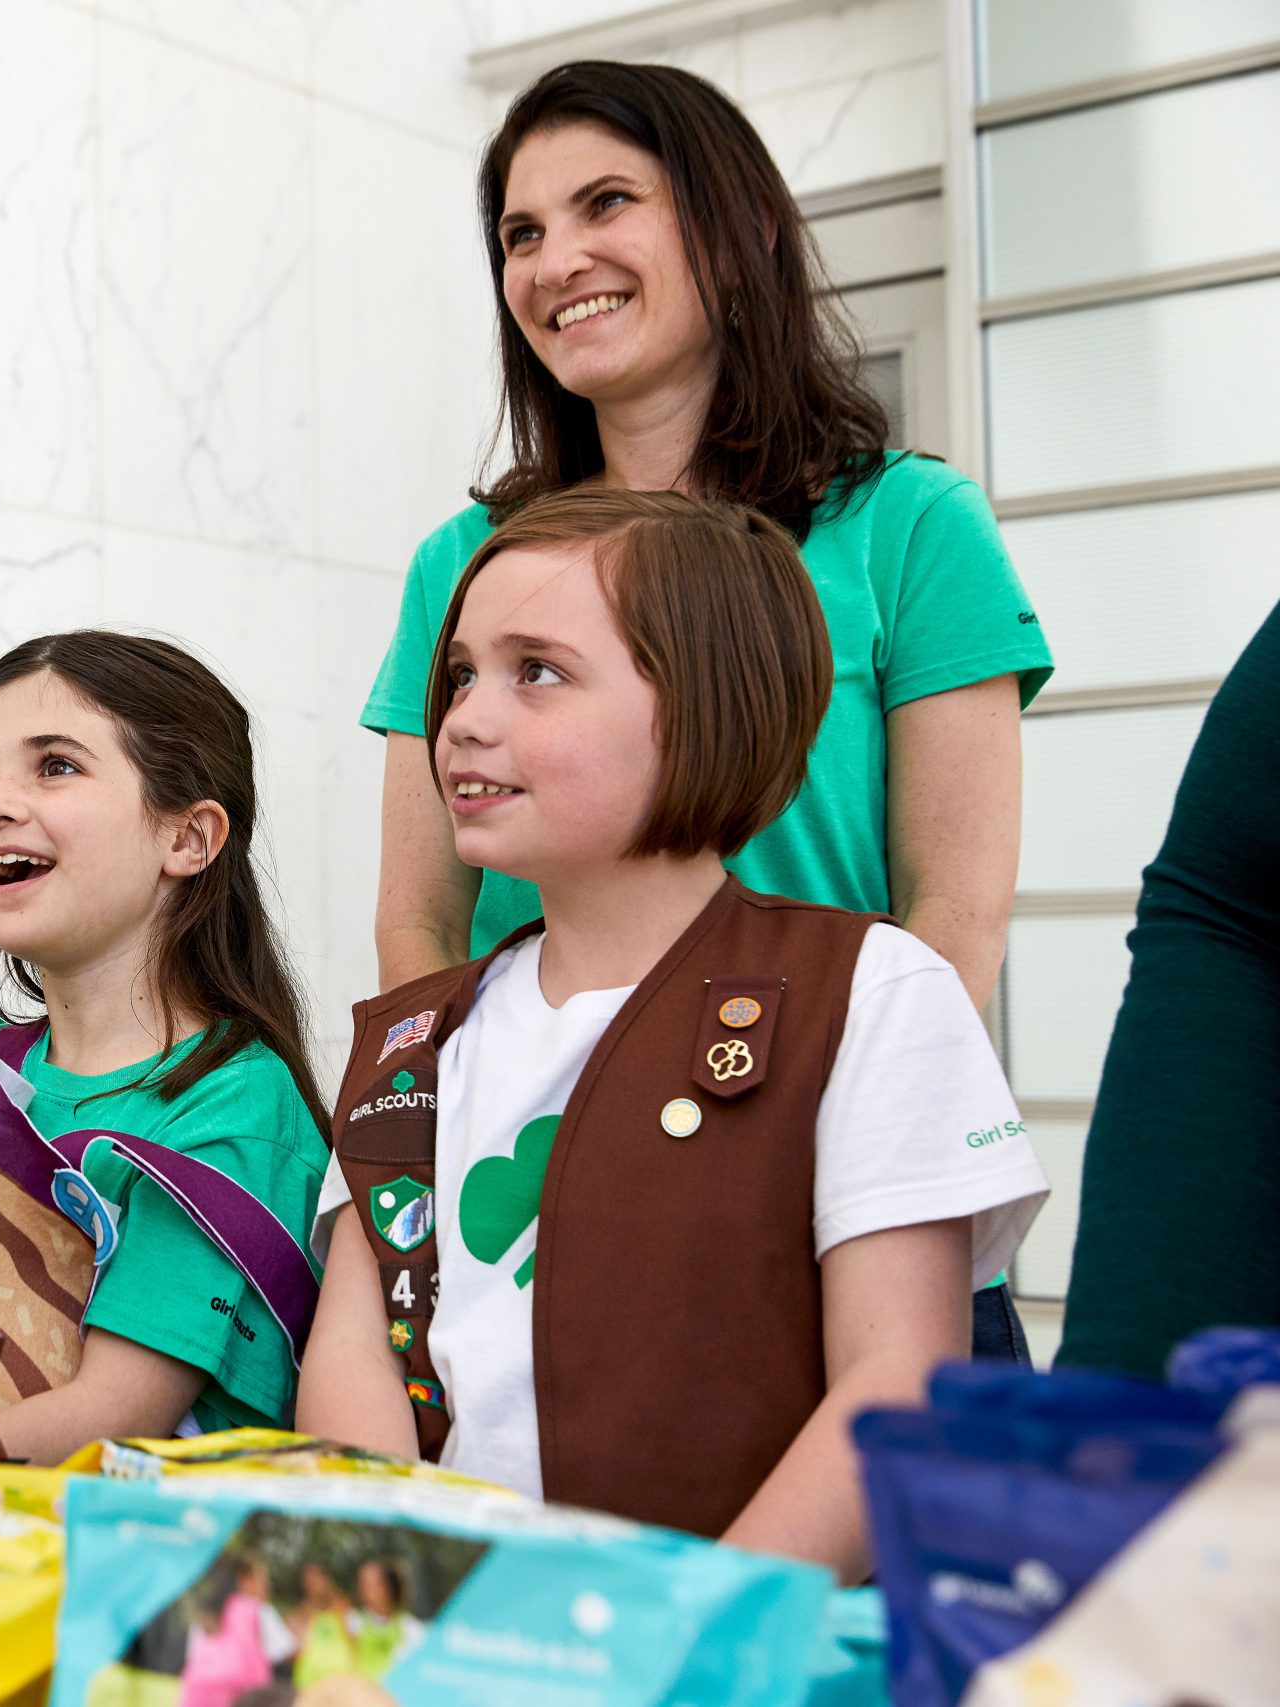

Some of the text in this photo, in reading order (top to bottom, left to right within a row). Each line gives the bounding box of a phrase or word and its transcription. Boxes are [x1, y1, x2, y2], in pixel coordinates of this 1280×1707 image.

[349, 1092, 437, 1122] GIRL SCOUTS
[966, 1125, 1003, 1149] Girl
[210, 1296, 236, 1319] Girl
